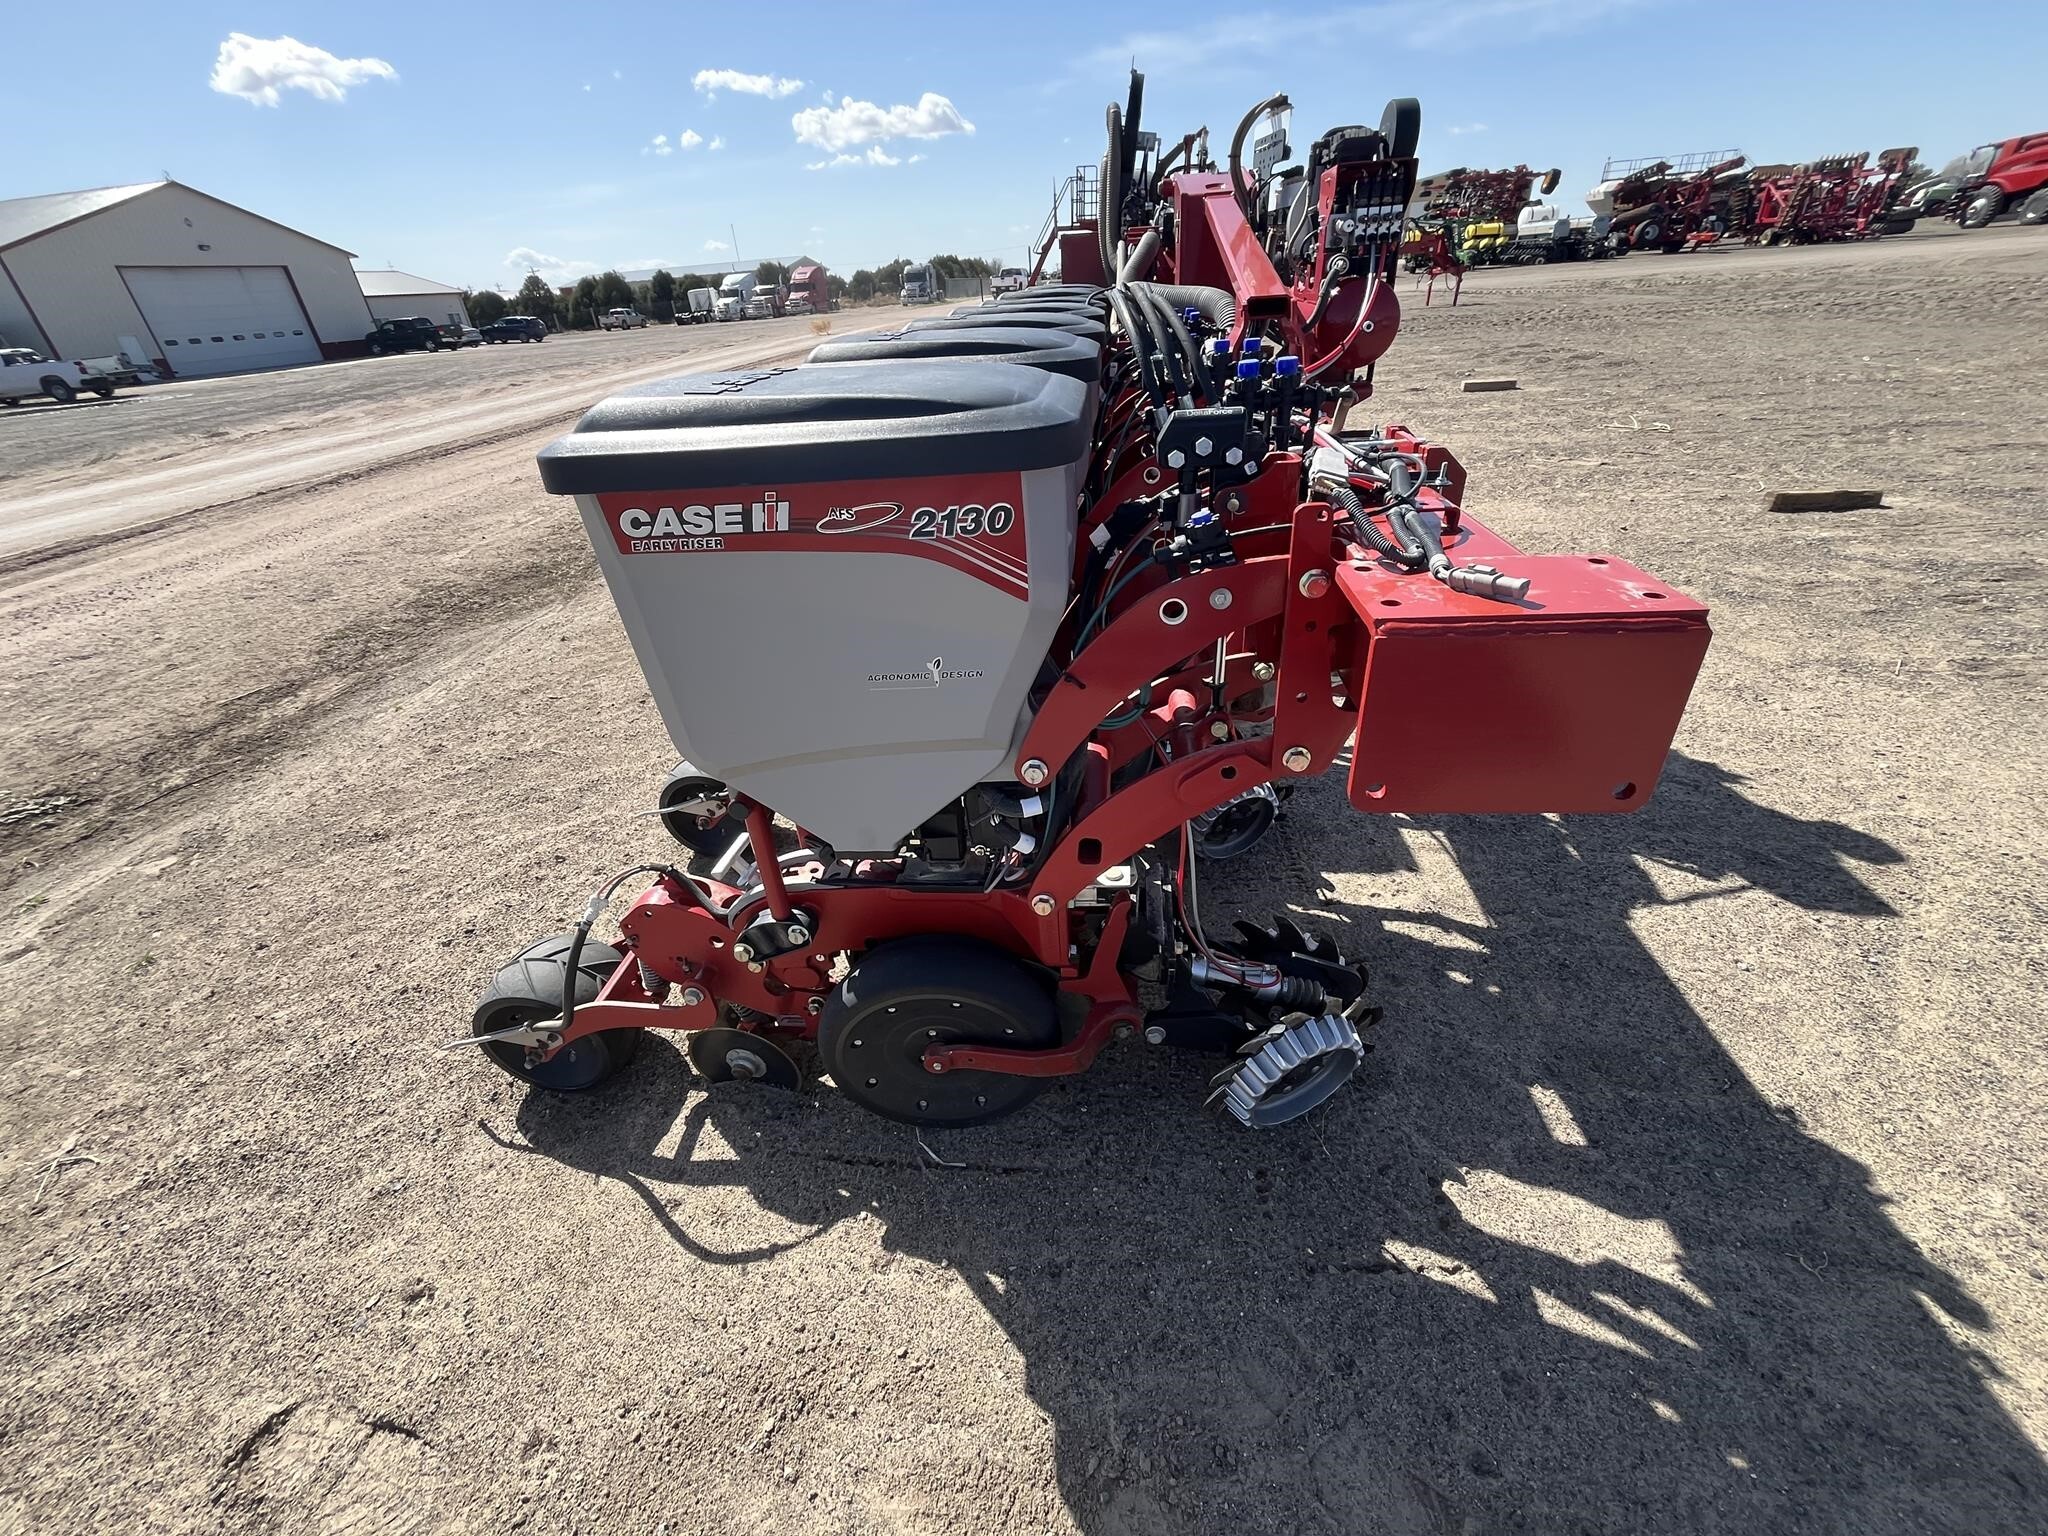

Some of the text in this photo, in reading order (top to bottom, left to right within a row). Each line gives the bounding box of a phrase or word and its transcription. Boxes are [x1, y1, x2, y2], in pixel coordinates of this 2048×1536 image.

[827, 506, 856, 520] AFS
[619, 504, 744, 538] CASE
[909, 503, 1015, 539] 2130
[631, 537, 724, 552] EARLY RISER
[867, 670, 984, 682] AGRONOMIC DESIGN
